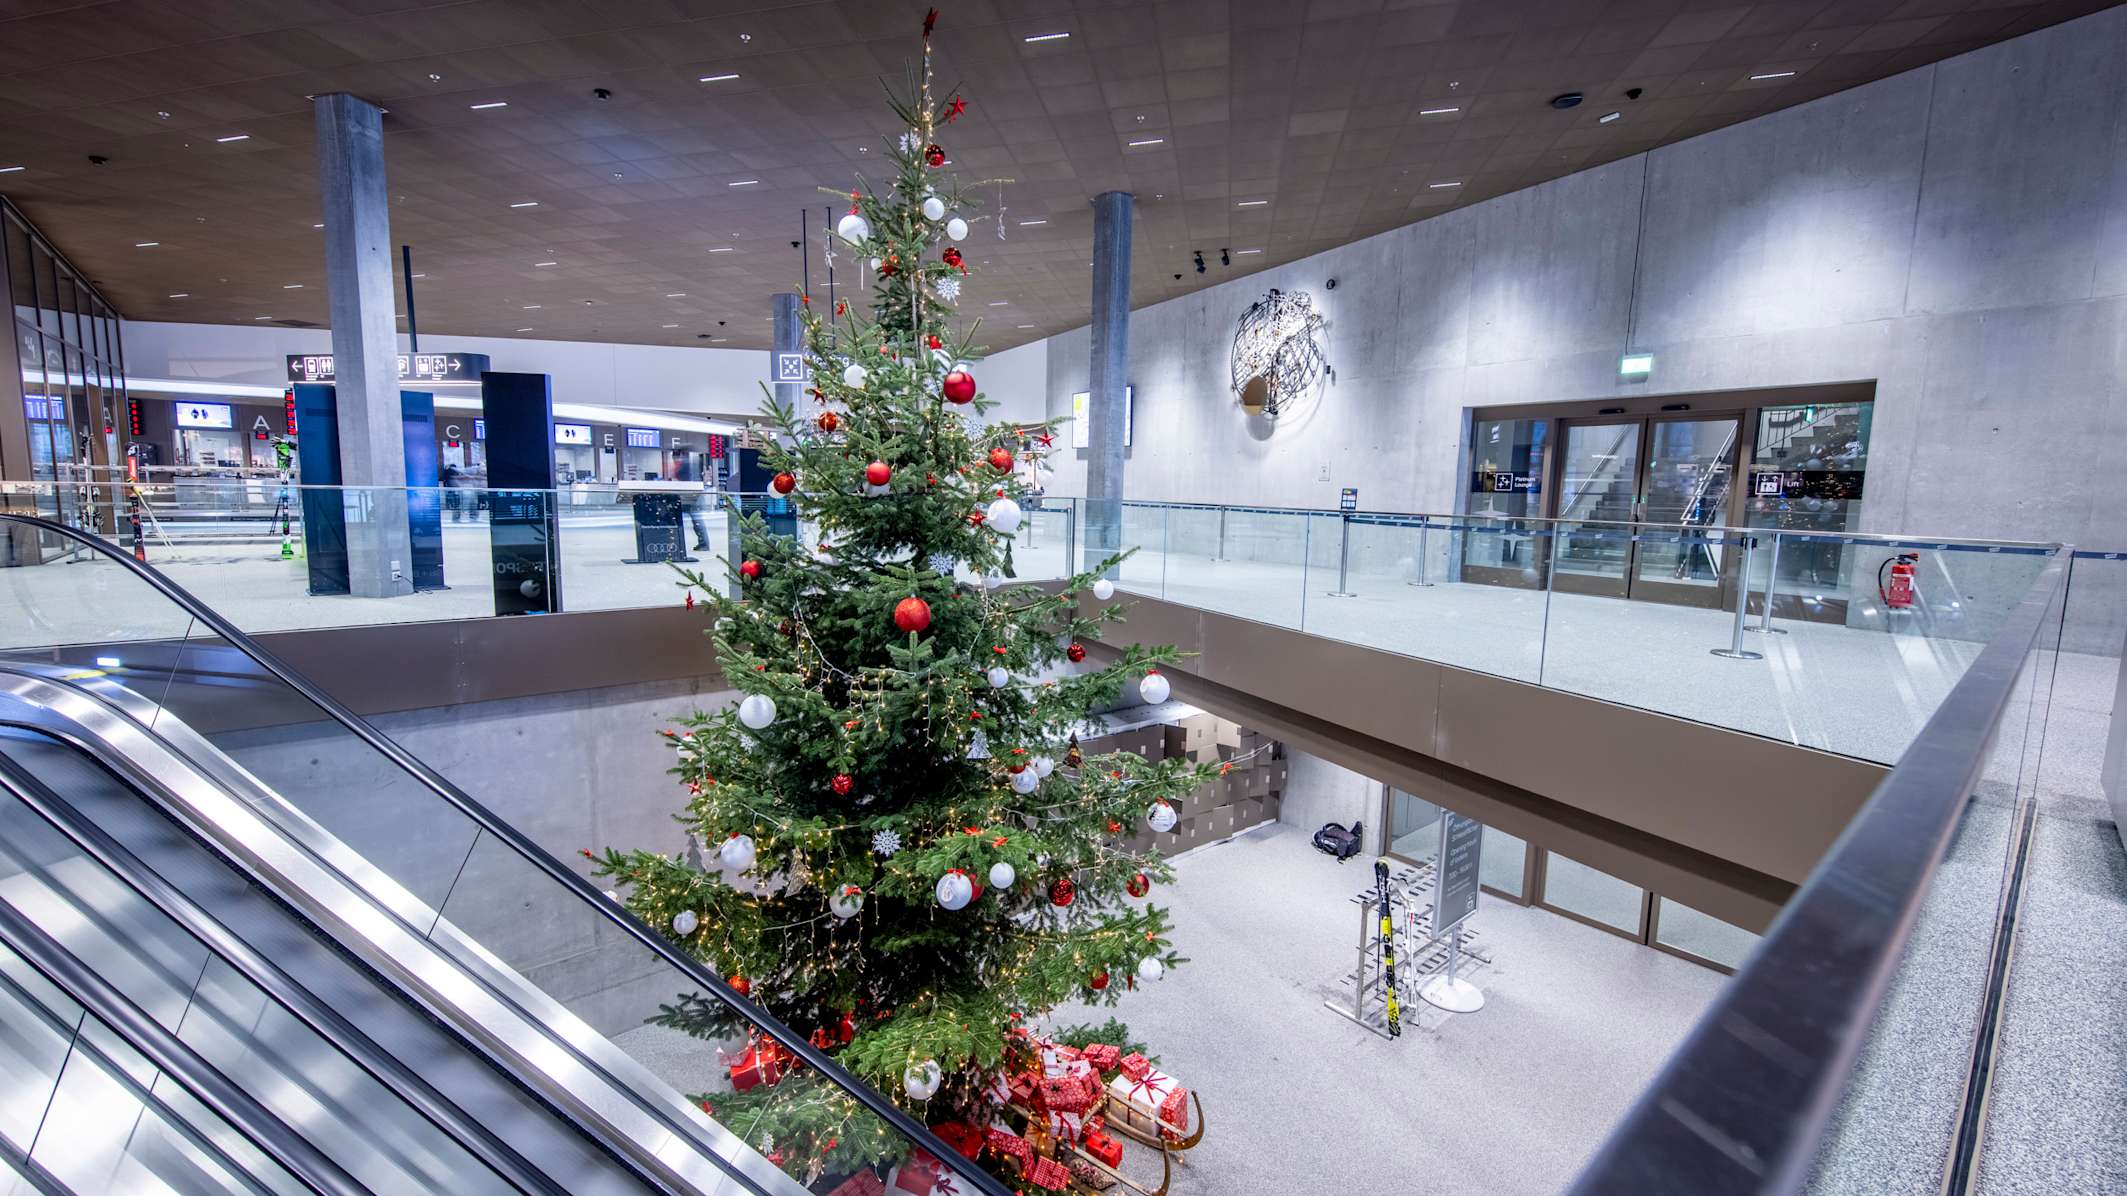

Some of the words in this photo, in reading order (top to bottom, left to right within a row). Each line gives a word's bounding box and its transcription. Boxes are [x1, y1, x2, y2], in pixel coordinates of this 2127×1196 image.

[253, 415, 270, 430] A
[446, 424, 460, 438] C
[604, 433, 614, 446] E
[671, 437, 681, 448] F
